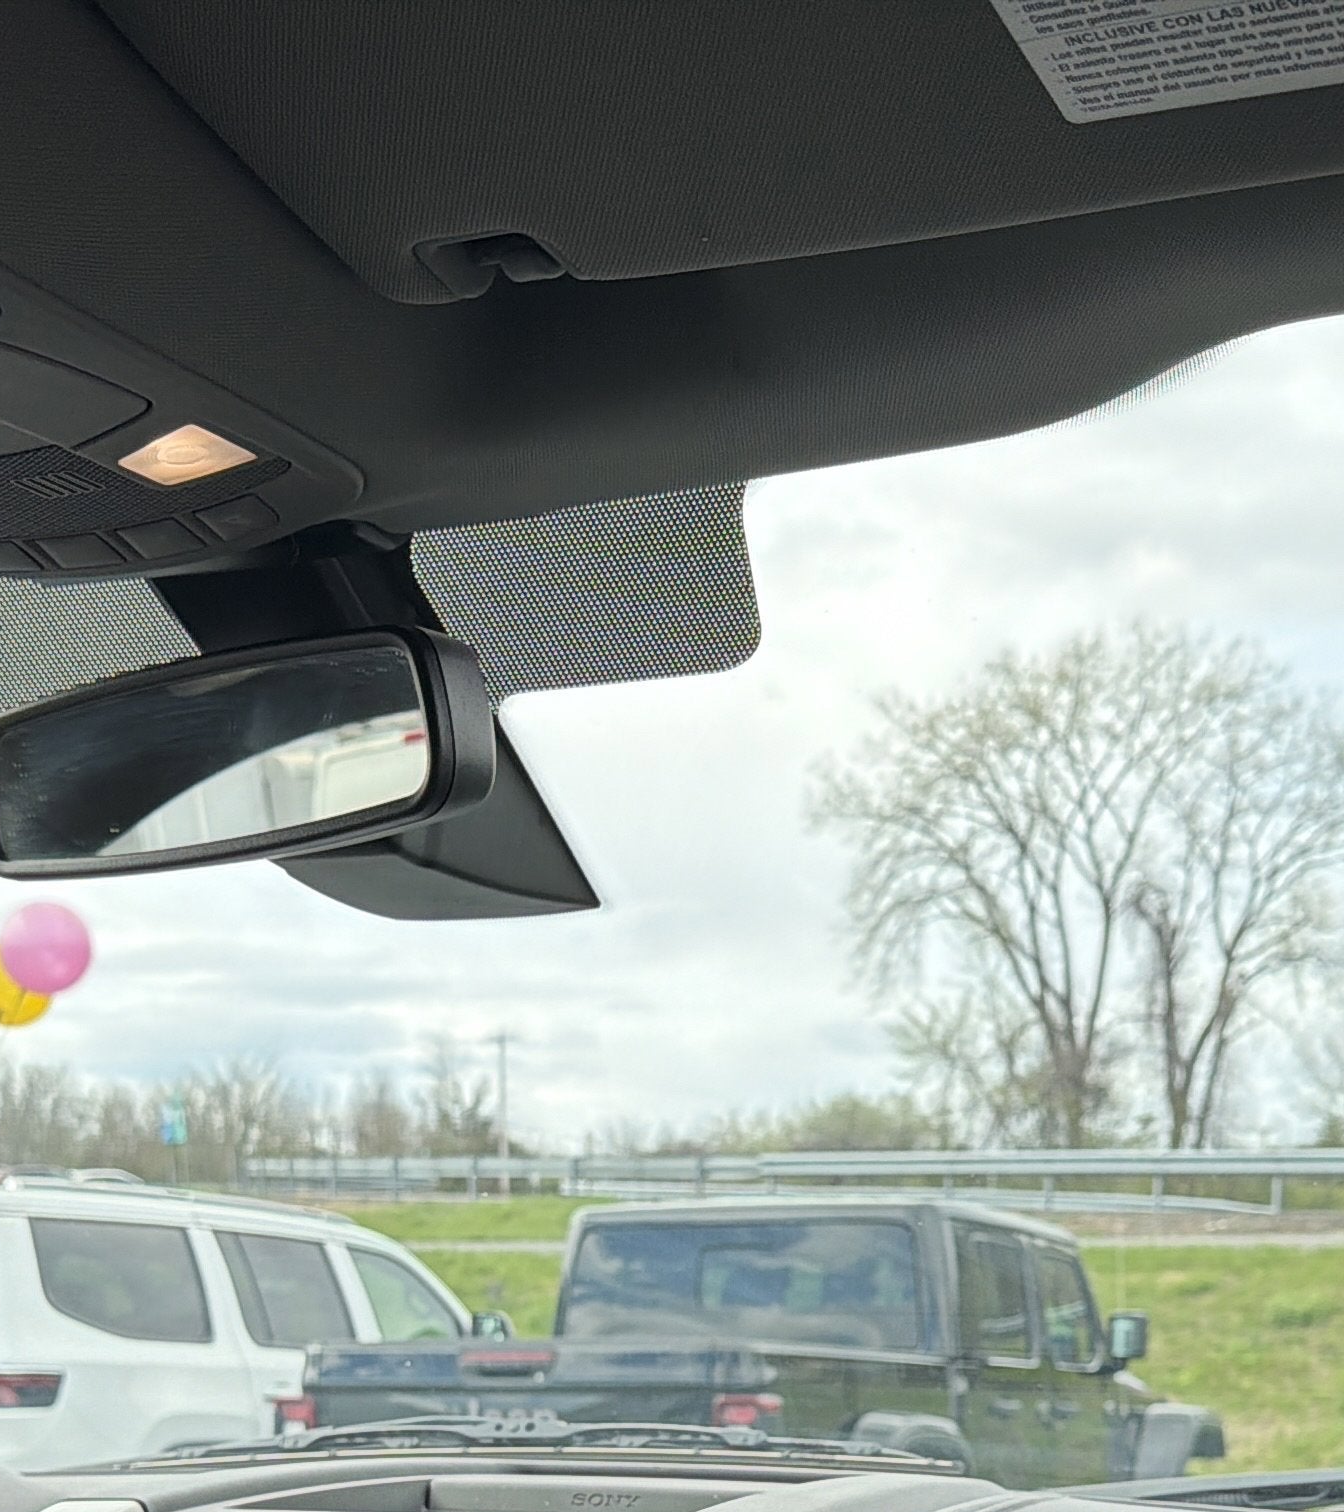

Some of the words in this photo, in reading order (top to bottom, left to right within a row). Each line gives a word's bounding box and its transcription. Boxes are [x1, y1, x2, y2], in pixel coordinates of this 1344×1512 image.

[1064, 20, 1159, 46] INCLUSIVE
[1162, 13, 1203, 30] CON
[1206, 5, 1245, 22] LAS
[570, 1492, 641, 1508] SONY
